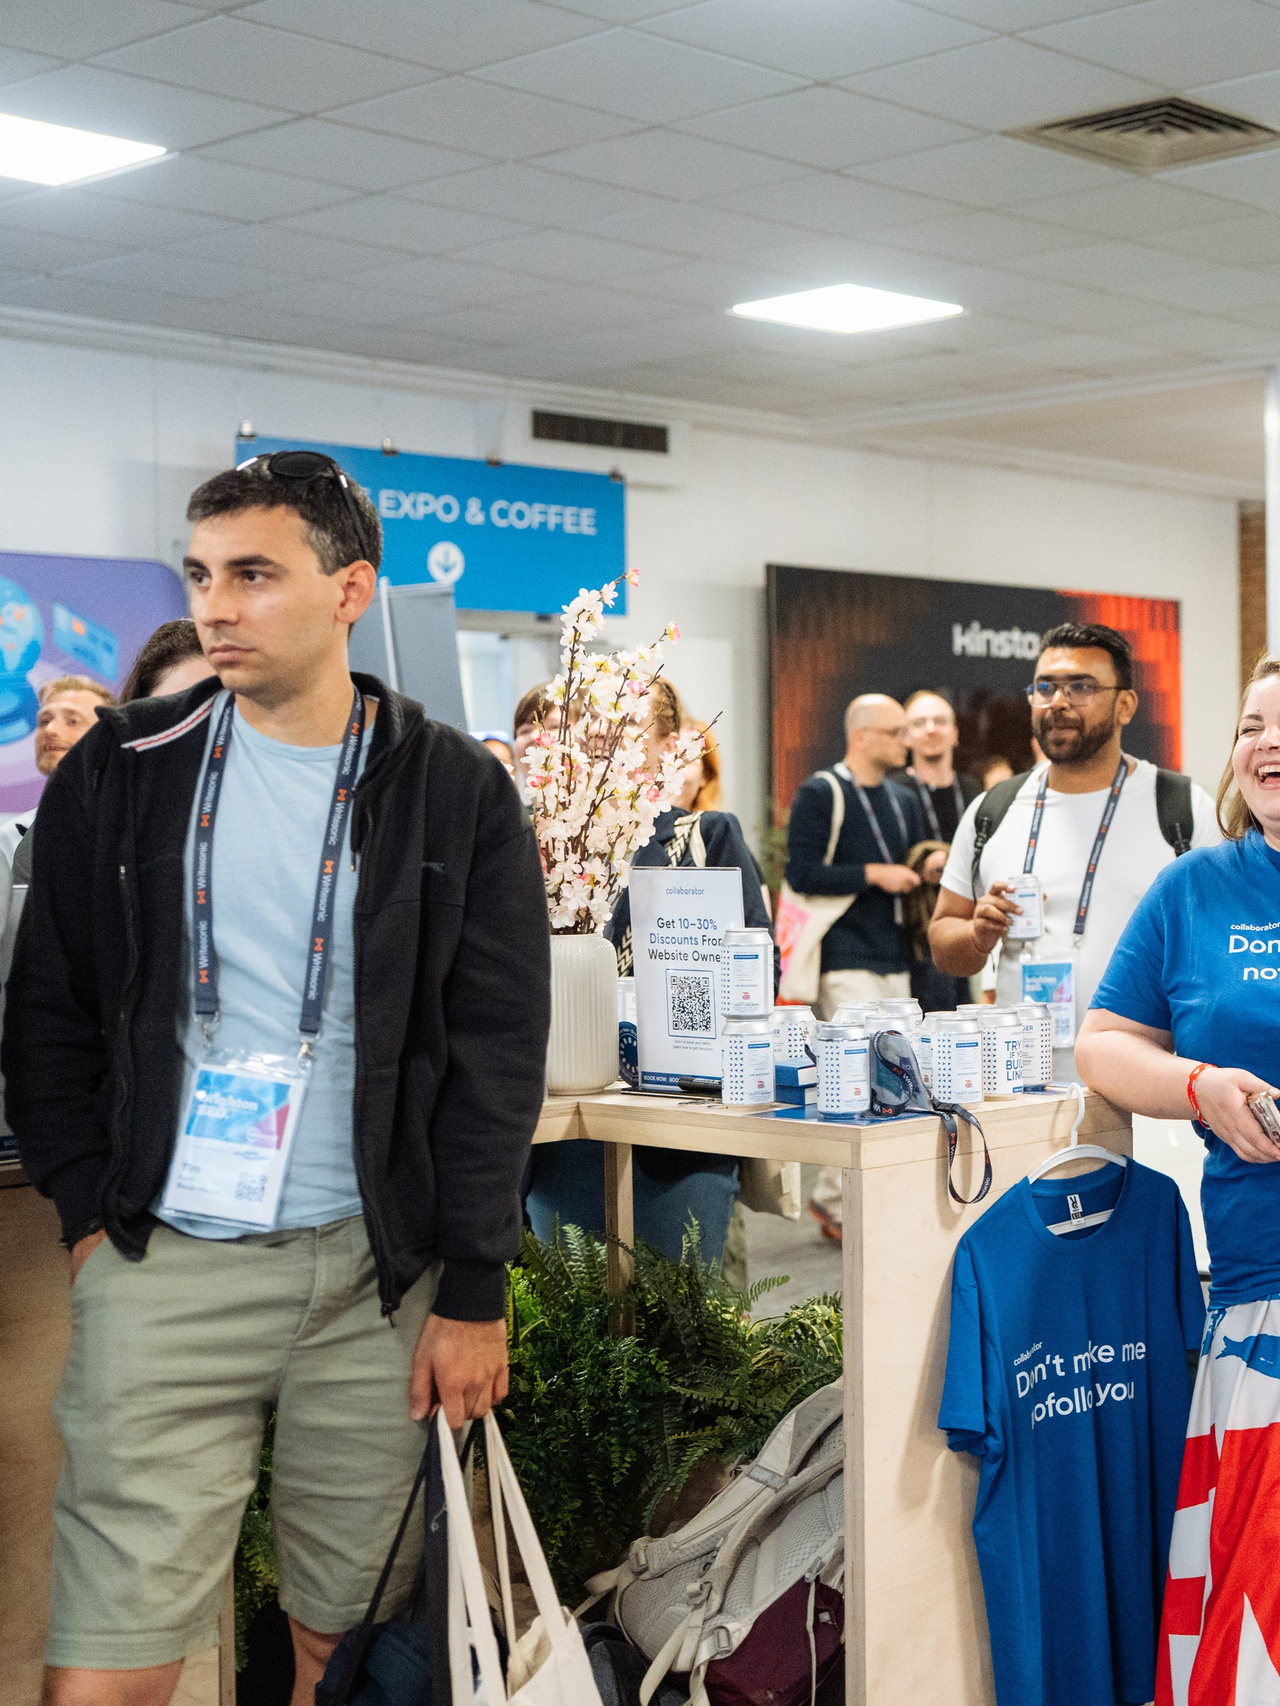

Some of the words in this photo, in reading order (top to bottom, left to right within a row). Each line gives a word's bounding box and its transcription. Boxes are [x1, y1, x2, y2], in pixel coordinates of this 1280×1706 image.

[378, 489, 460, 523] EXPO
[464, 497, 486, 526] &
[490, 499, 598, 536] COFFEE
[665, 886, 705, 895] collaborator
[656, 917, 676, 929] Get
[1230, 921, 1280, 932] collaborator
[649, 932, 699, 946] Discounts
[647, 948, 689, 961] Website
[692, 950, 721, 963] Owne
[1004, 1041, 1022, 1052] TRY
[1073, 1340, 1115, 1374] mke
[1121, 1341, 1146, 1362] me
[1095, 1381, 1135, 1407] you
